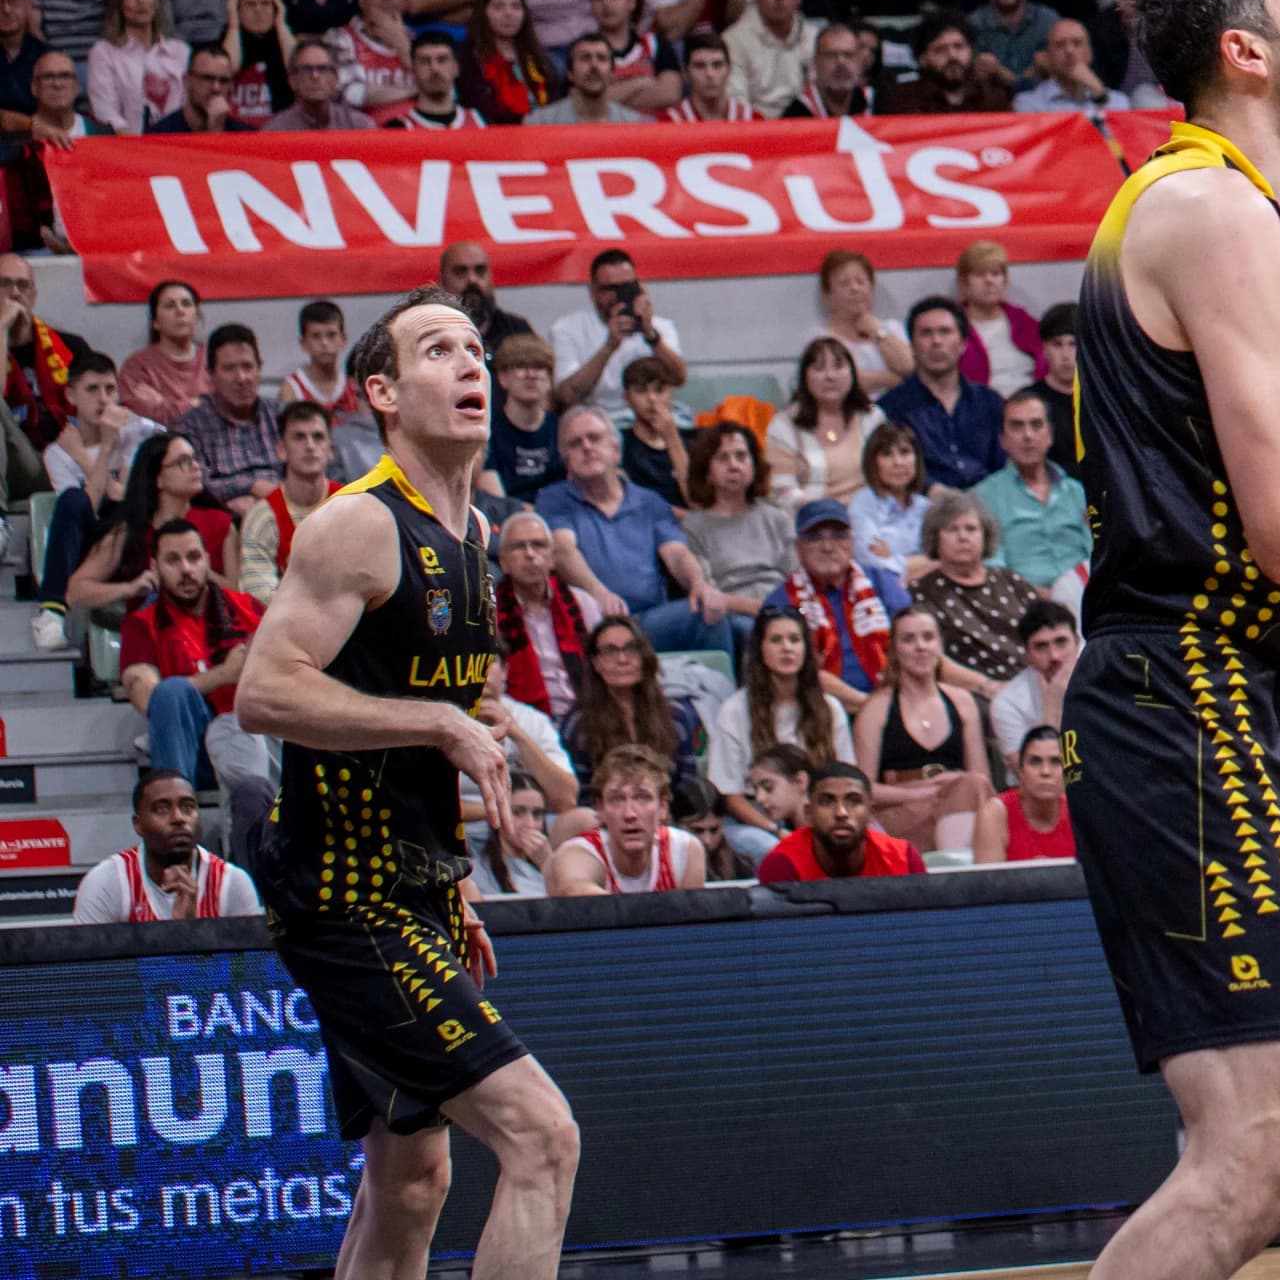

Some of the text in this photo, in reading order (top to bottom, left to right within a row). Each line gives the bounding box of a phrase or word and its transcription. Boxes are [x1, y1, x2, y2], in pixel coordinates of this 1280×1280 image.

[409, 655, 452, 688] LA
[165, 987, 321, 1041] BANC
[47, 1180, 141, 1235] tus
